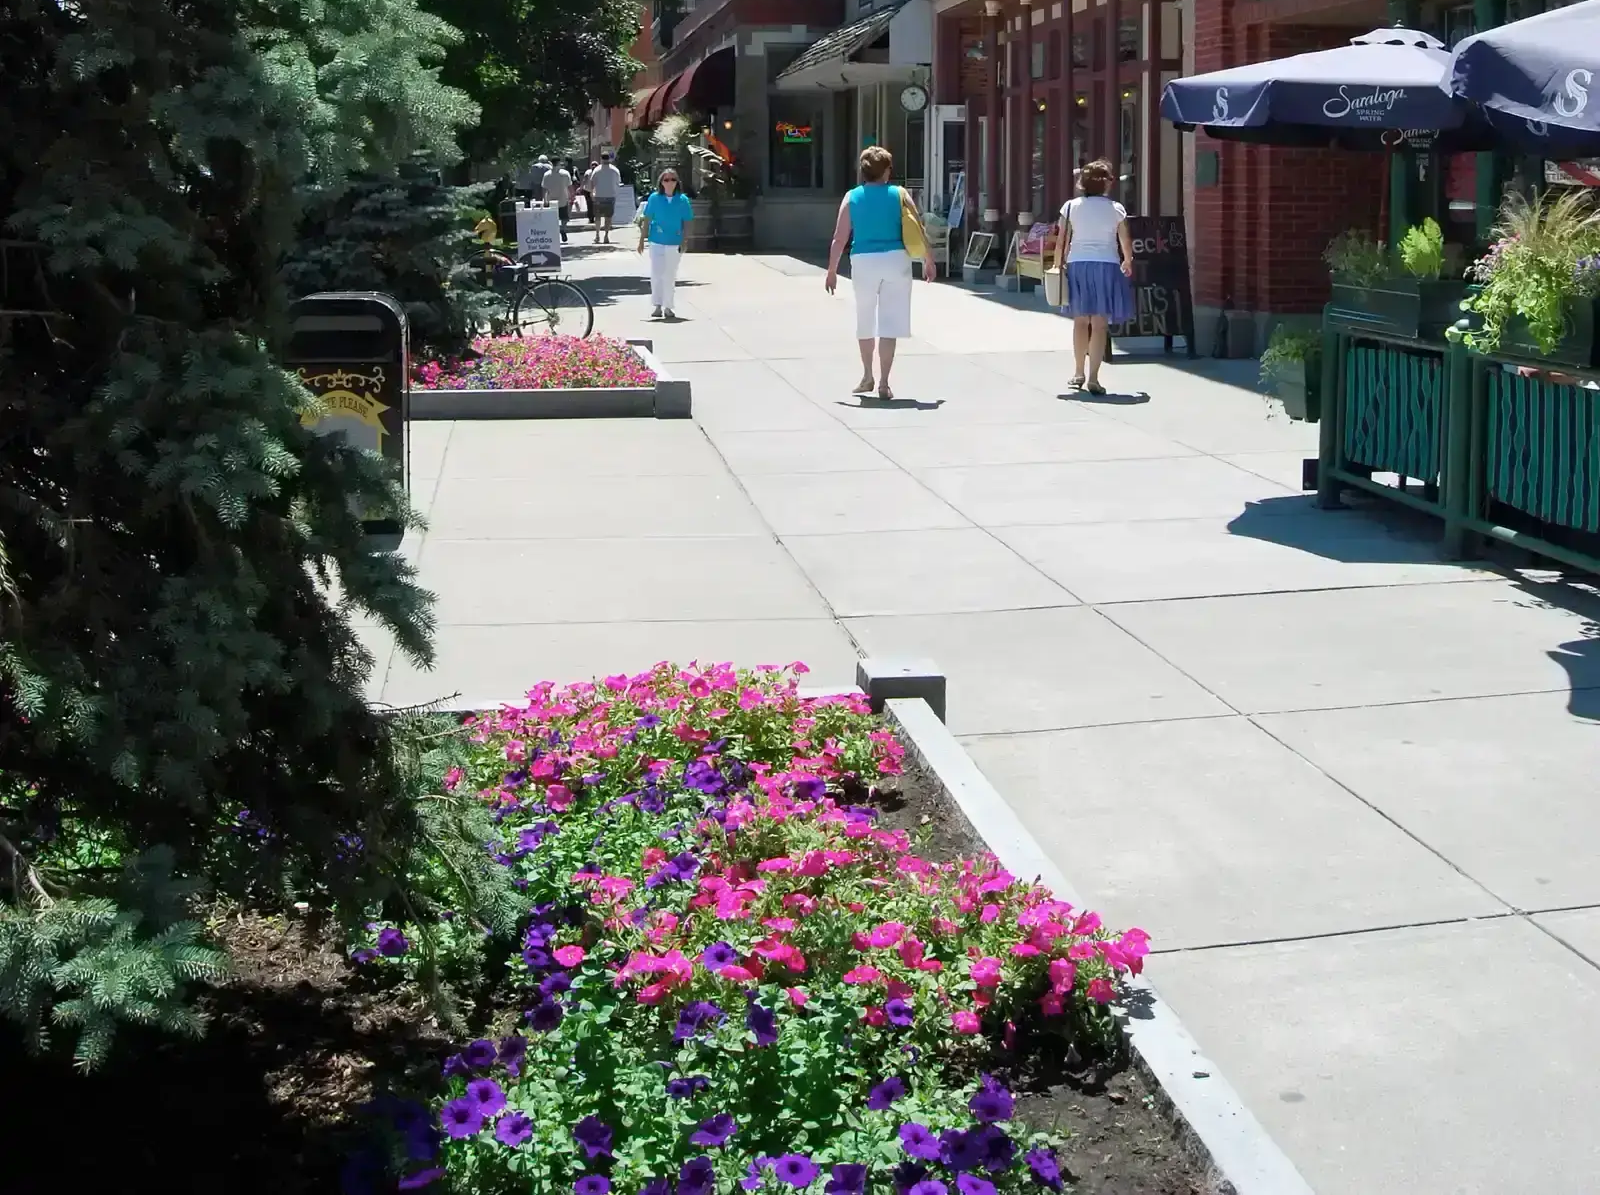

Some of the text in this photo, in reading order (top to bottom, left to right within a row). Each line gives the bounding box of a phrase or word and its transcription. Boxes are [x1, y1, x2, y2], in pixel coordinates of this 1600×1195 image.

[1323, 85, 1404, 118] Saratoga
[1132, 230, 1169, 253] eck
[339, 396, 369, 418] PLEASE
